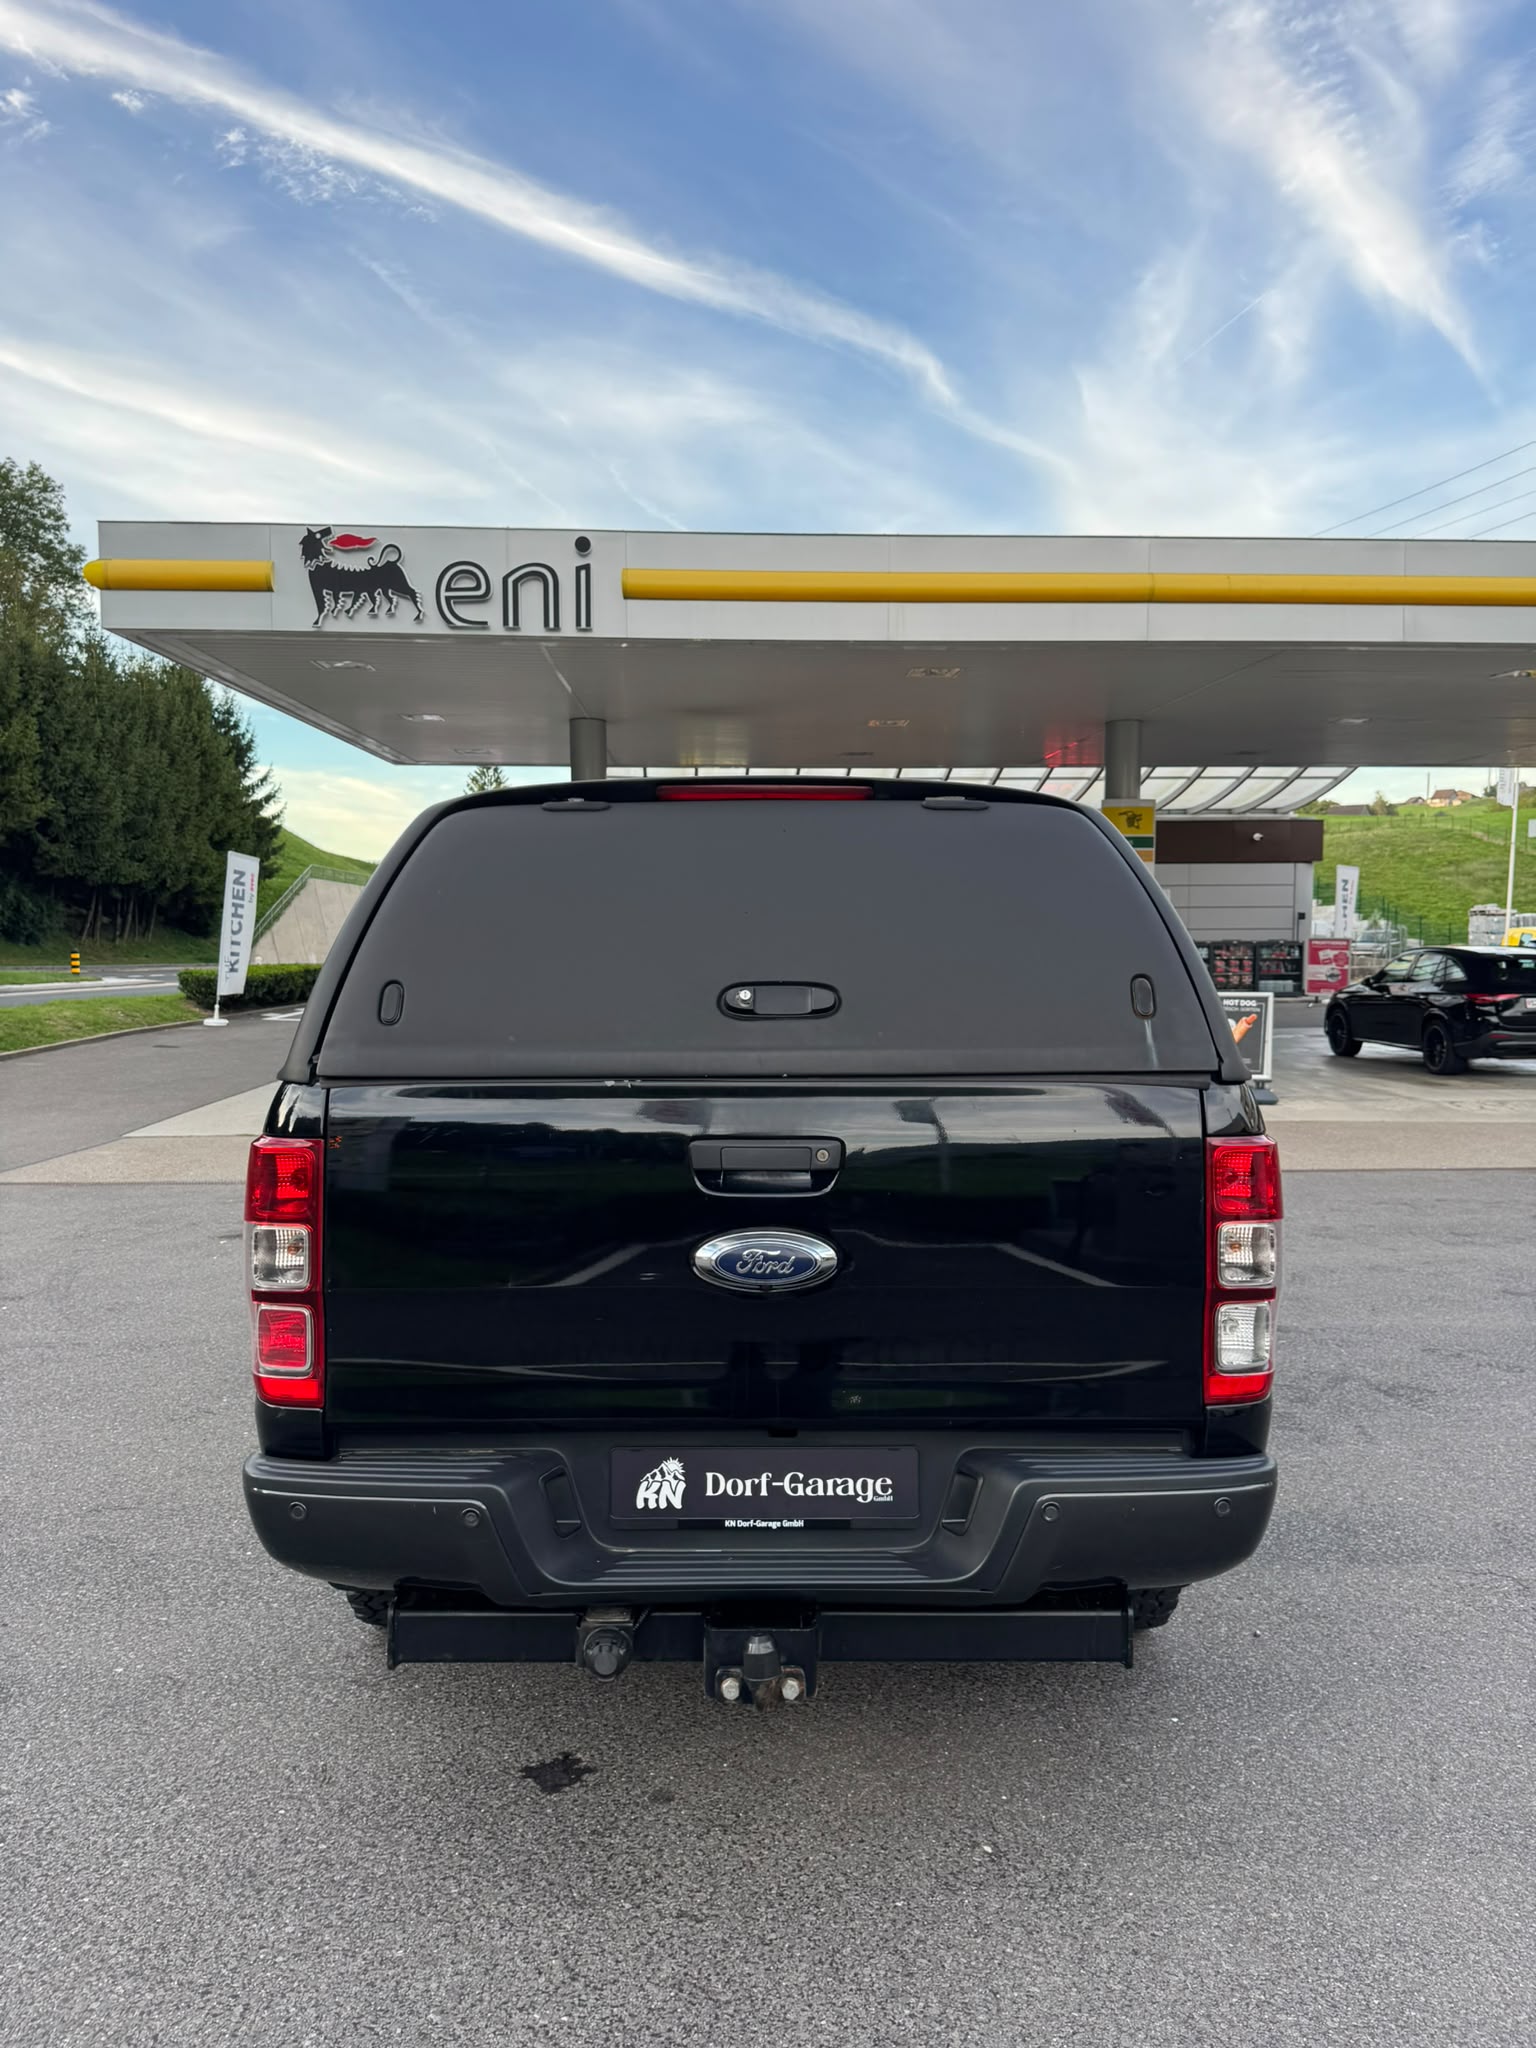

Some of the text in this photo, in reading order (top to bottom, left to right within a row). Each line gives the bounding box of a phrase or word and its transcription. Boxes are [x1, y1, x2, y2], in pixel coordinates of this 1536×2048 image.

[435, 535, 593, 631] eni
[229, 869, 246, 973] KITCHEN
[736, 1248, 796, 1275] Ford
[635, 1472, 893, 1510] KN Dorf-Garage
[725, 1519, 804, 1529] KN Dorf-Garage GmbH
